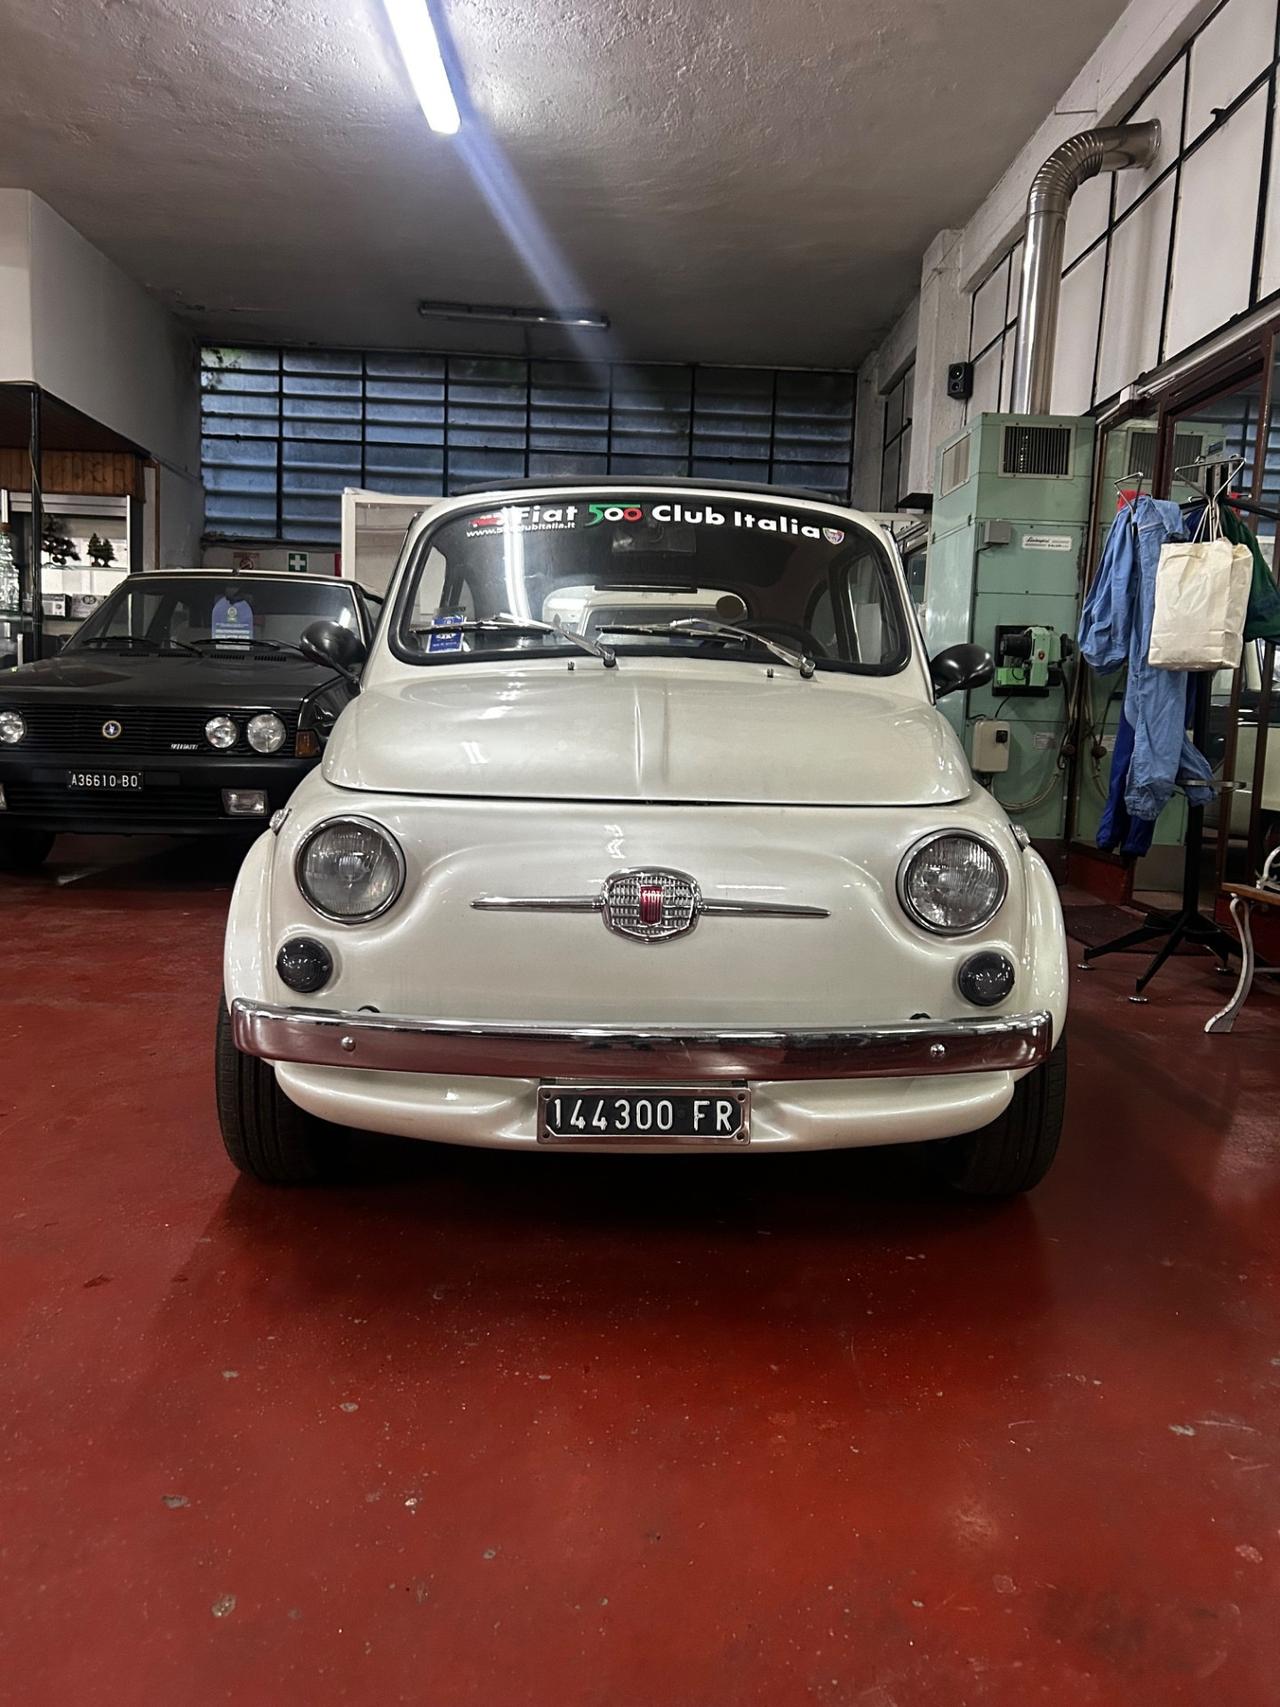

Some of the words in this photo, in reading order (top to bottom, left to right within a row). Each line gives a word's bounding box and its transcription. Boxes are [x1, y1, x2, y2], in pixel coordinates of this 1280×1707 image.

[517, 505, 578, 523] Fiat
[584, 503, 643, 527] 500
[651, 504, 726, 526] Club
[734, 511, 820, 539] Italia
[71, 773, 117, 788] A36610
[122, 774, 138, 788] BO
[553, 1098, 674, 1131] 144300
[693, 1100, 733, 1132] FR
